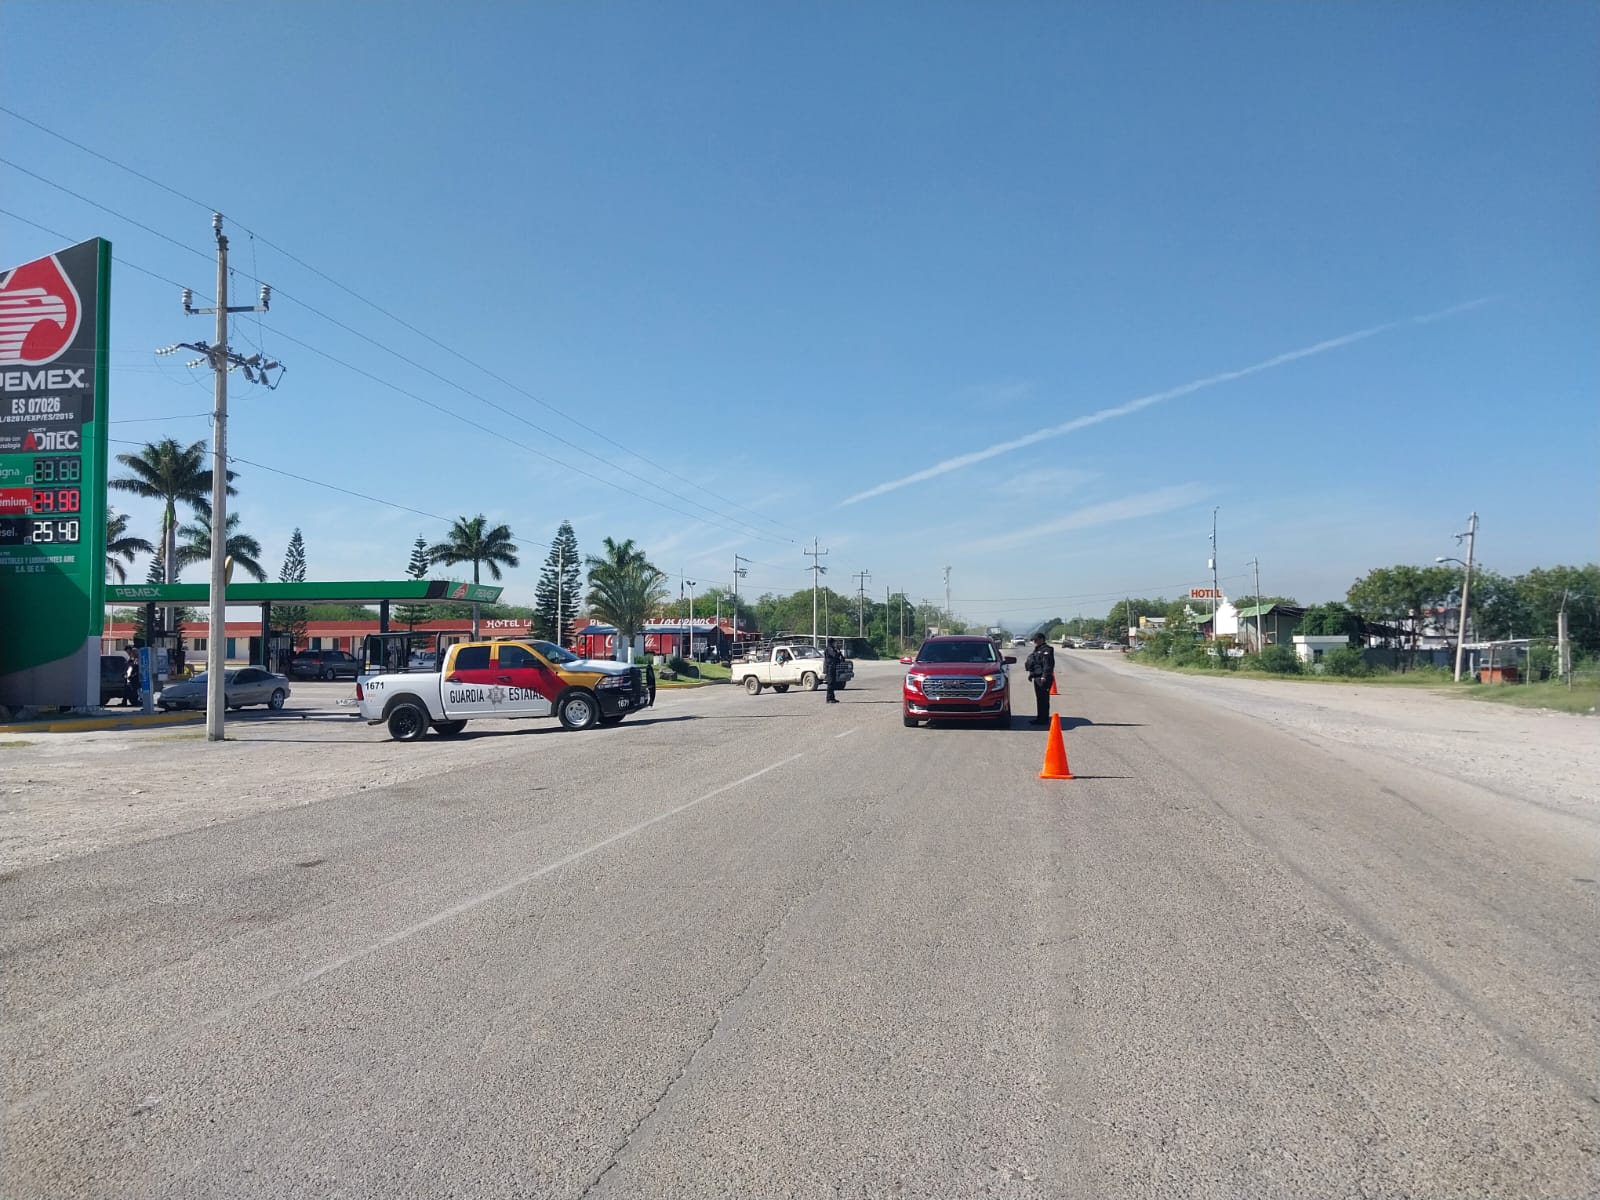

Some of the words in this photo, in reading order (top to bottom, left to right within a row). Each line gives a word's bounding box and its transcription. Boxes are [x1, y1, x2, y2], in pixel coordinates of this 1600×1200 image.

[0, 368, 85, 391] EMEX
[12, 399, 26, 414] ES
[28, 397, 61, 413] 07026
[115, 588, 162, 597] PEMEX
[486, 619, 520, 628] HOTEL
[366, 681, 384, 691] 1671
[450, 690, 485, 704] GUARDIA
